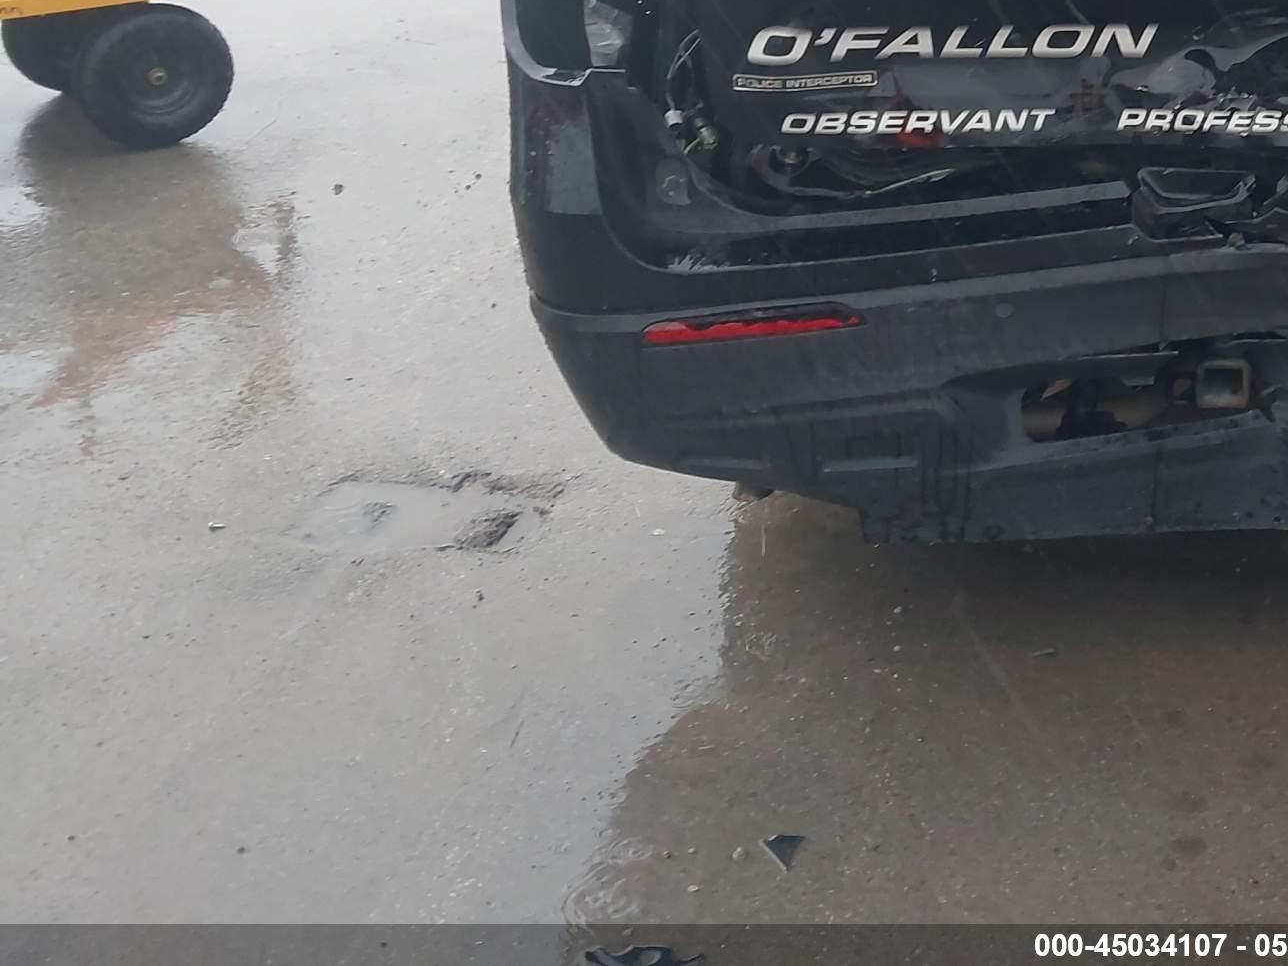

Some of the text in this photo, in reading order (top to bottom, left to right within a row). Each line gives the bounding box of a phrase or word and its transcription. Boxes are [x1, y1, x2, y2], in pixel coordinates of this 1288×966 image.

[746, 23, 1159, 66] O'FALLON
[737, 74, 873, 89] POLICE INTERCEPTOR
[780, 107, 1056, 135] OBSERVANT
